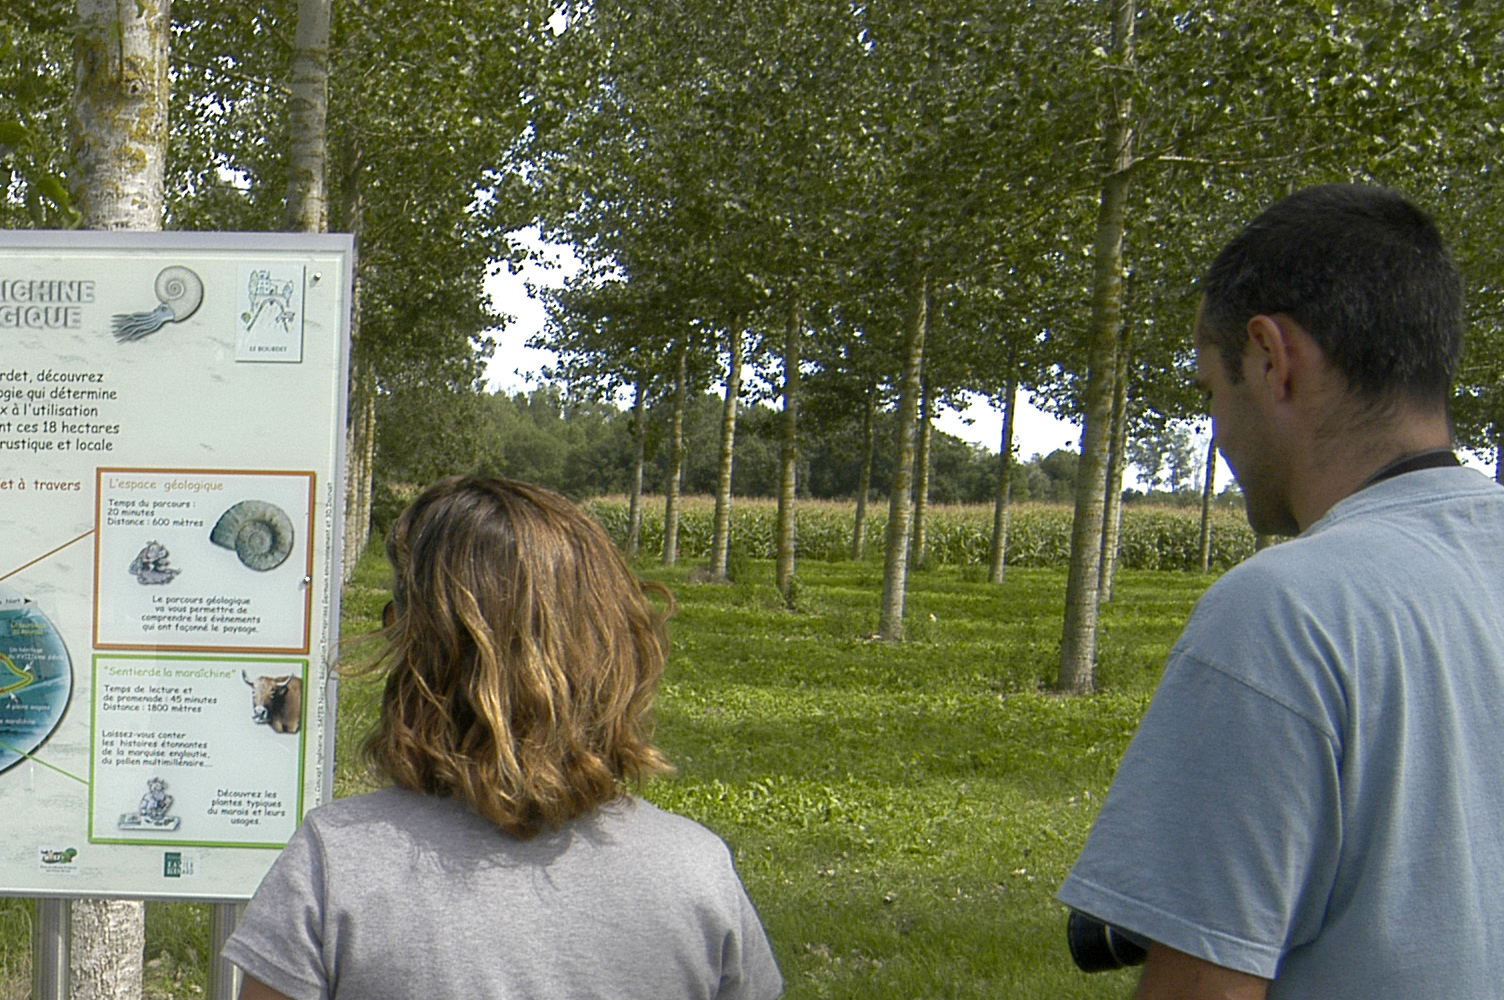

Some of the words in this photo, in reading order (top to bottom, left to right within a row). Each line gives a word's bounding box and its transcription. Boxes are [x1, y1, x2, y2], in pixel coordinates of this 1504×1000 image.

[37, 369, 103, 383] découvrez
[27, 387, 45, 402] qui
[50, 386, 117, 400] détermine
[12, 403, 19, 415] à
[24, 403, 98, 417] l'utilisation
[17, 423, 38, 433] ces
[43, 421, 57, 433] 18
[62, 421, 120, 434] hectares
[0, 438, 53, 453] rustique
[57, 439, 71, 450] et
[76, 438, 113, 451] locale
[18, 477, 25, 490] à
[33, 479, 80, 491] travers
[109, 478, 156, 492] L'espace
[164, 479, 223, 493] géologique
[108, 508, 119, 516] 20
[121, 509, 155, 517] minutes
[107, 517, 144, 526] Distance
[152, 518, 170, 526] 600
[173, 518, 203, 527] mètres
[103, 703, 139, 711] Distance
[148, 704, 168, 712] 1800
[171, 704, 202, 713] mètres
